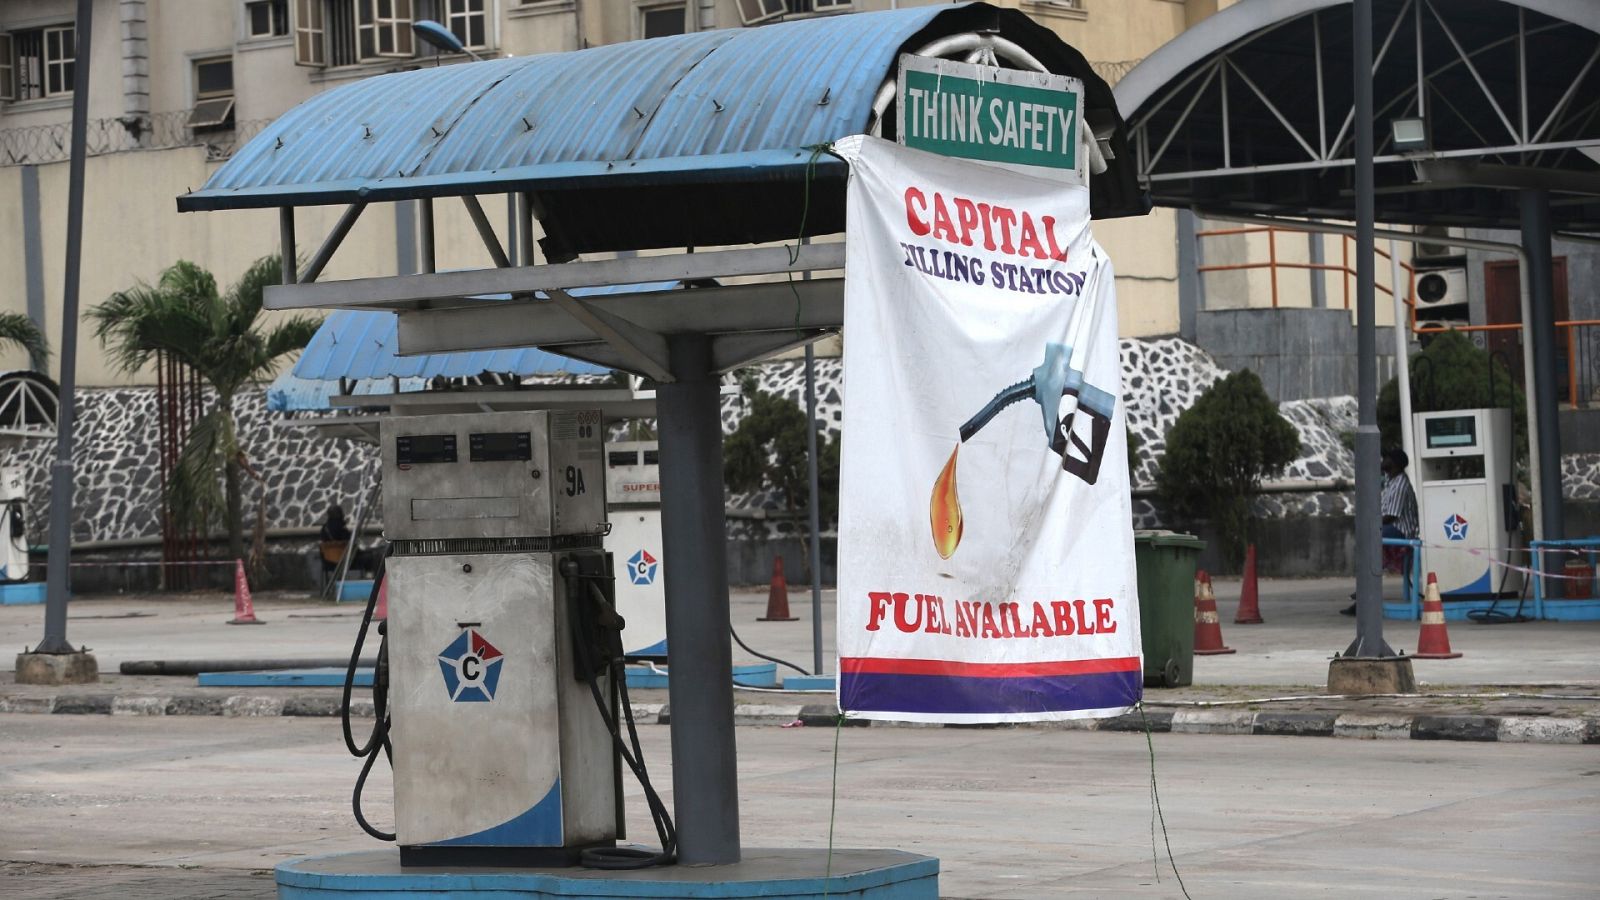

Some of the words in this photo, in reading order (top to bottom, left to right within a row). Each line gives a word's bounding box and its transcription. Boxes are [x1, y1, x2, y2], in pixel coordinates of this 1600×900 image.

[908, 87, 983, 144] THINK
[989, 97, 1074, 155] SAFETY
[904, 186, 1068, 263] CAPITAL
[566, 465, 586, 497] 9A
[638, 562, 646, 574] C
[866, 591, 952, 636] FUEL
[956, 598, 1117, 639] AVAILABLE
[463, 657, 480, 681] C
